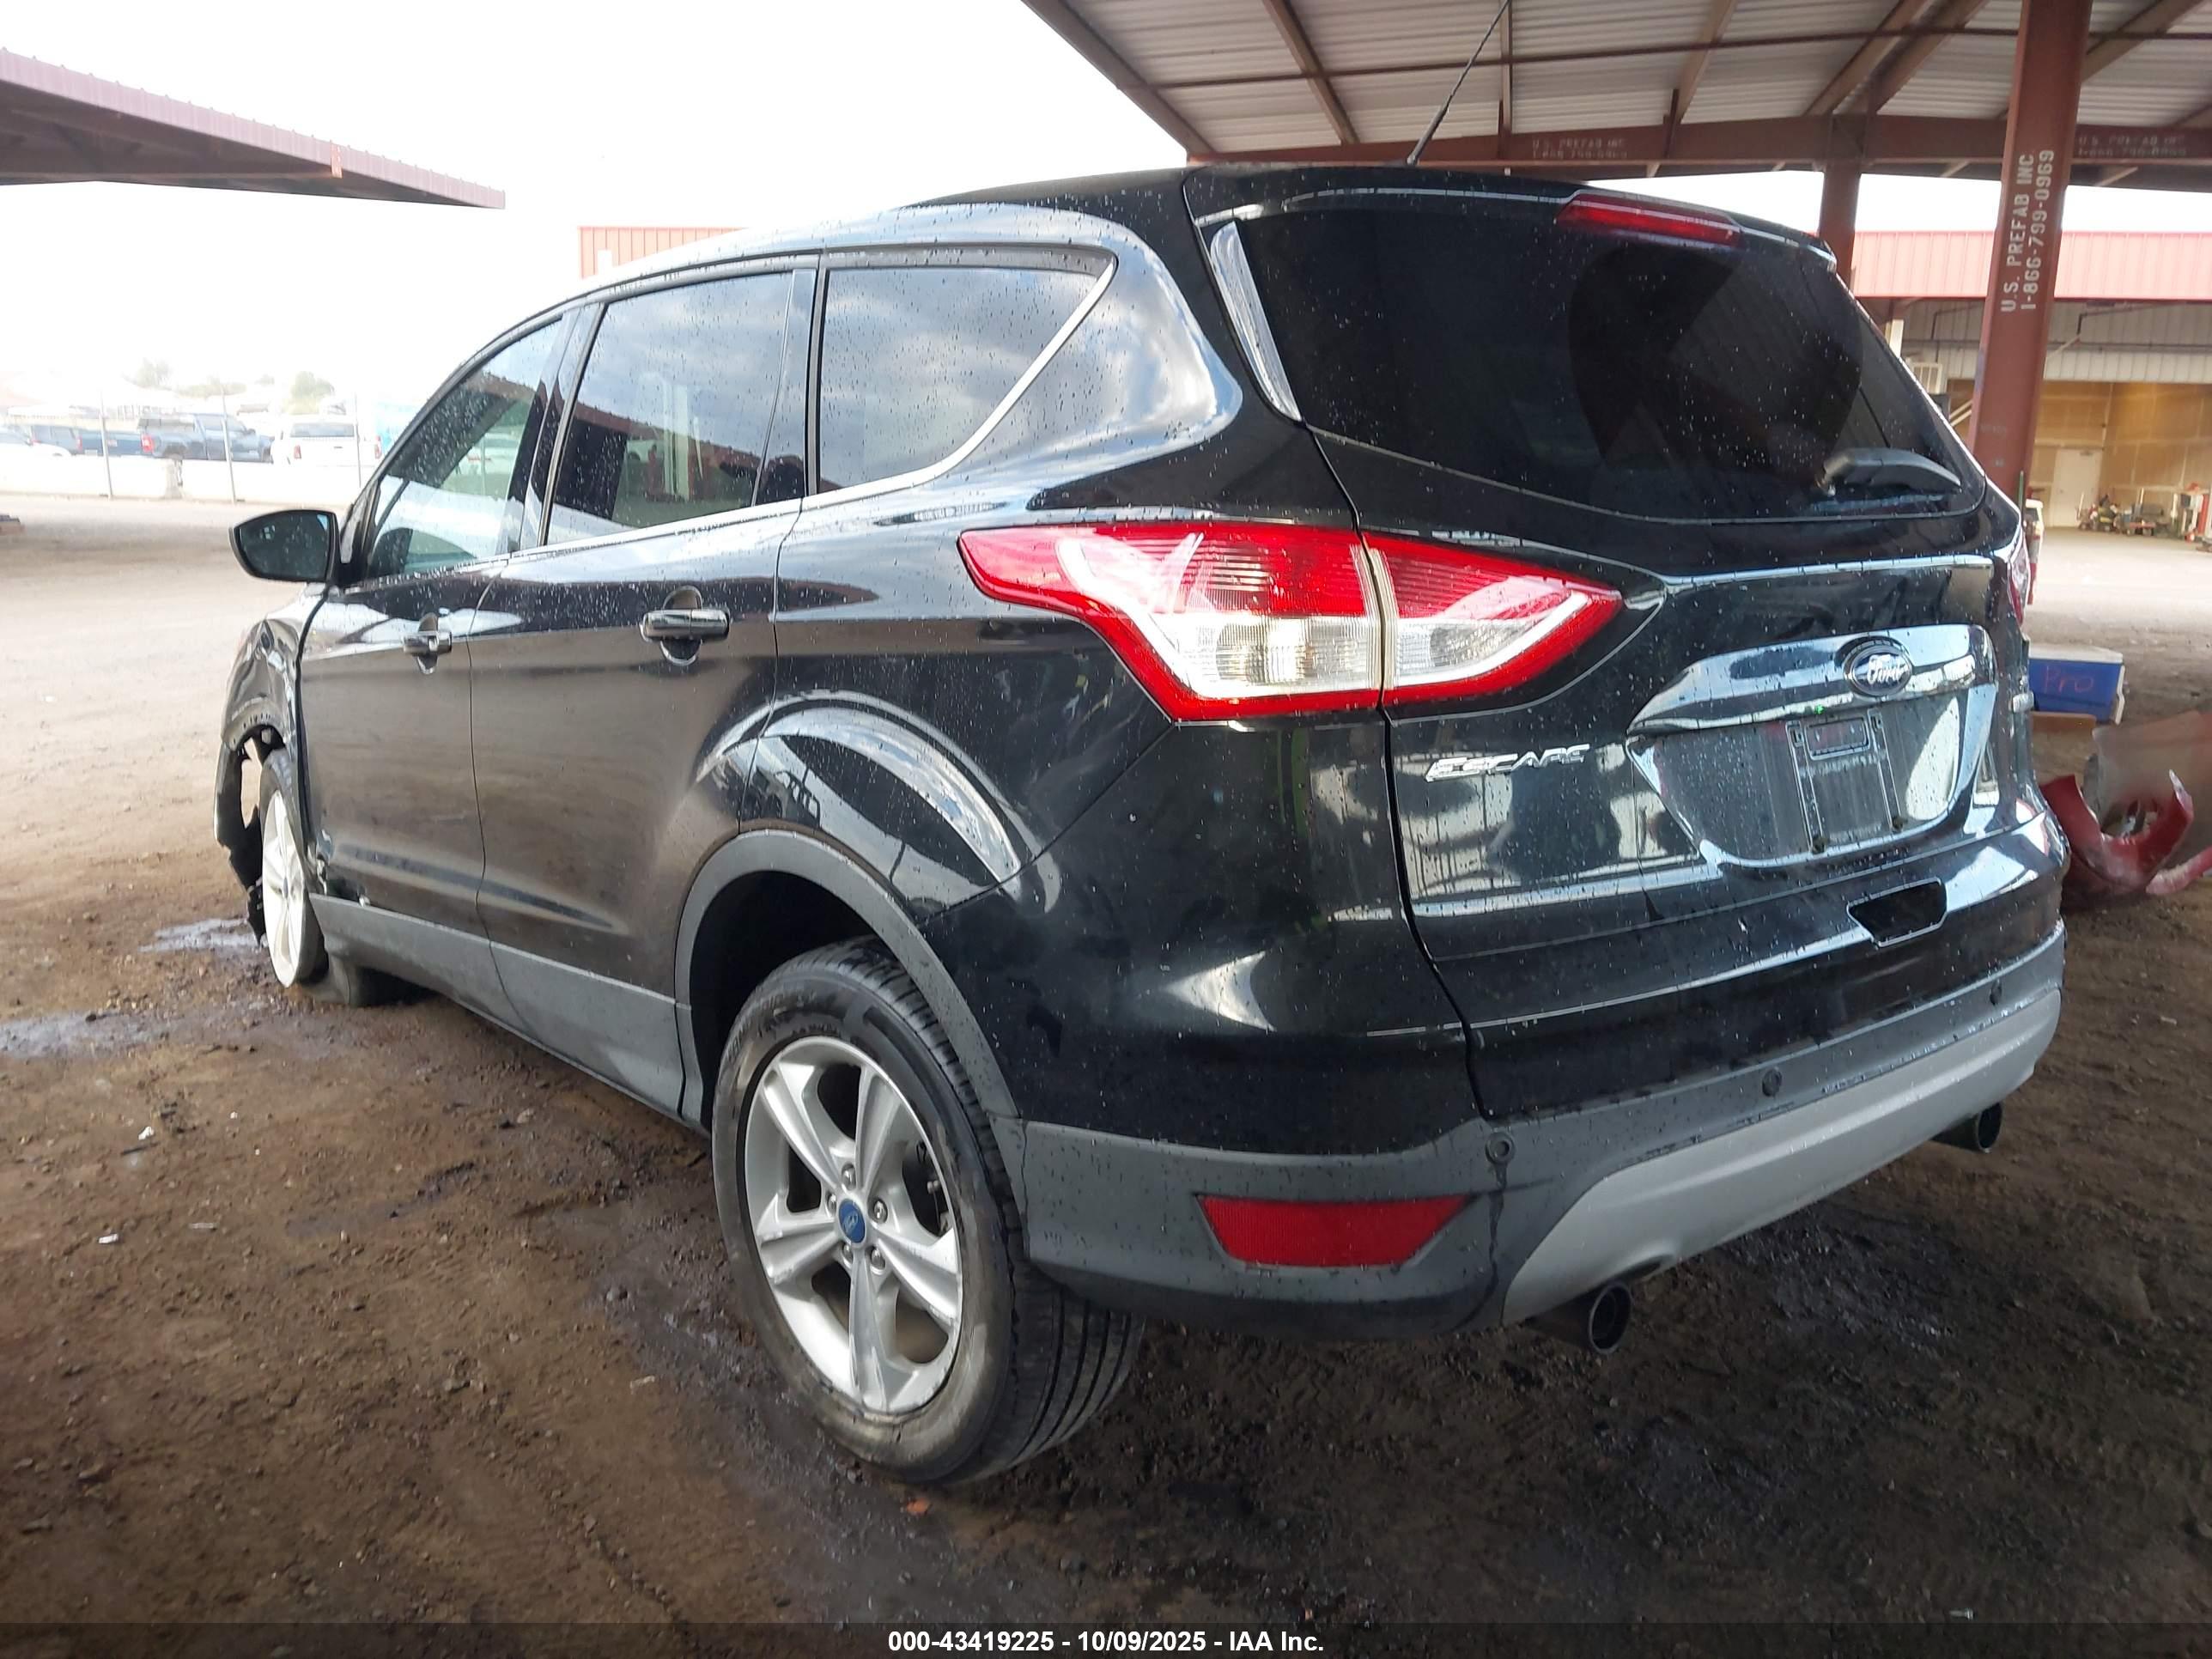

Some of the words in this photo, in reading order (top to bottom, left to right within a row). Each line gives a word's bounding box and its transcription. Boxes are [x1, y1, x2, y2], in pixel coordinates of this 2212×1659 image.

[2016, 155, 2034, 185] INC
[2007, 193, 2030, 266] PREFAB
[2021, 149, 2055, 310] 1-866-799-0969
[2001, 276, 2020, 312] U.S.
[1425, 744, 1589, 782] ESCAPE
